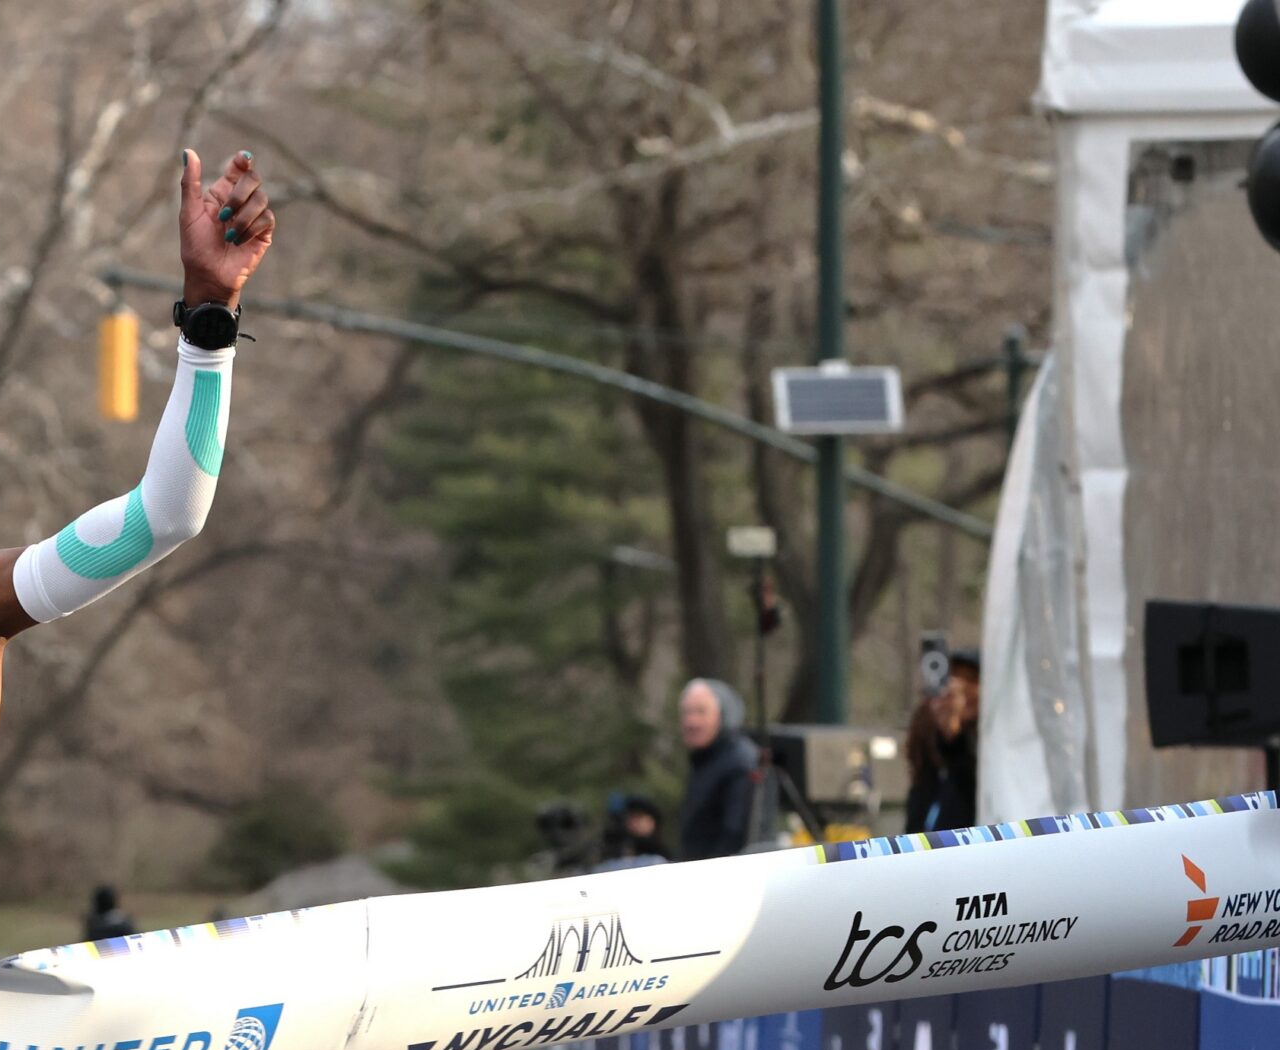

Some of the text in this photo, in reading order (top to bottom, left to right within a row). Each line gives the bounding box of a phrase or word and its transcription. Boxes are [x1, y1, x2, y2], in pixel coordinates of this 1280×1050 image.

[955, 891, 1009, 922] TATA
[1221, 891, 1263, 918] NEW
[942, 915, 1079, 953] CONSULTANCY
[1207, 920, 1263, 943] ROAD
[823, 910, 938, 991] tcs
[920, 952, 1016, 979] SERVICES
[468, 975, 670, 1016] UNITED AIRLINES
